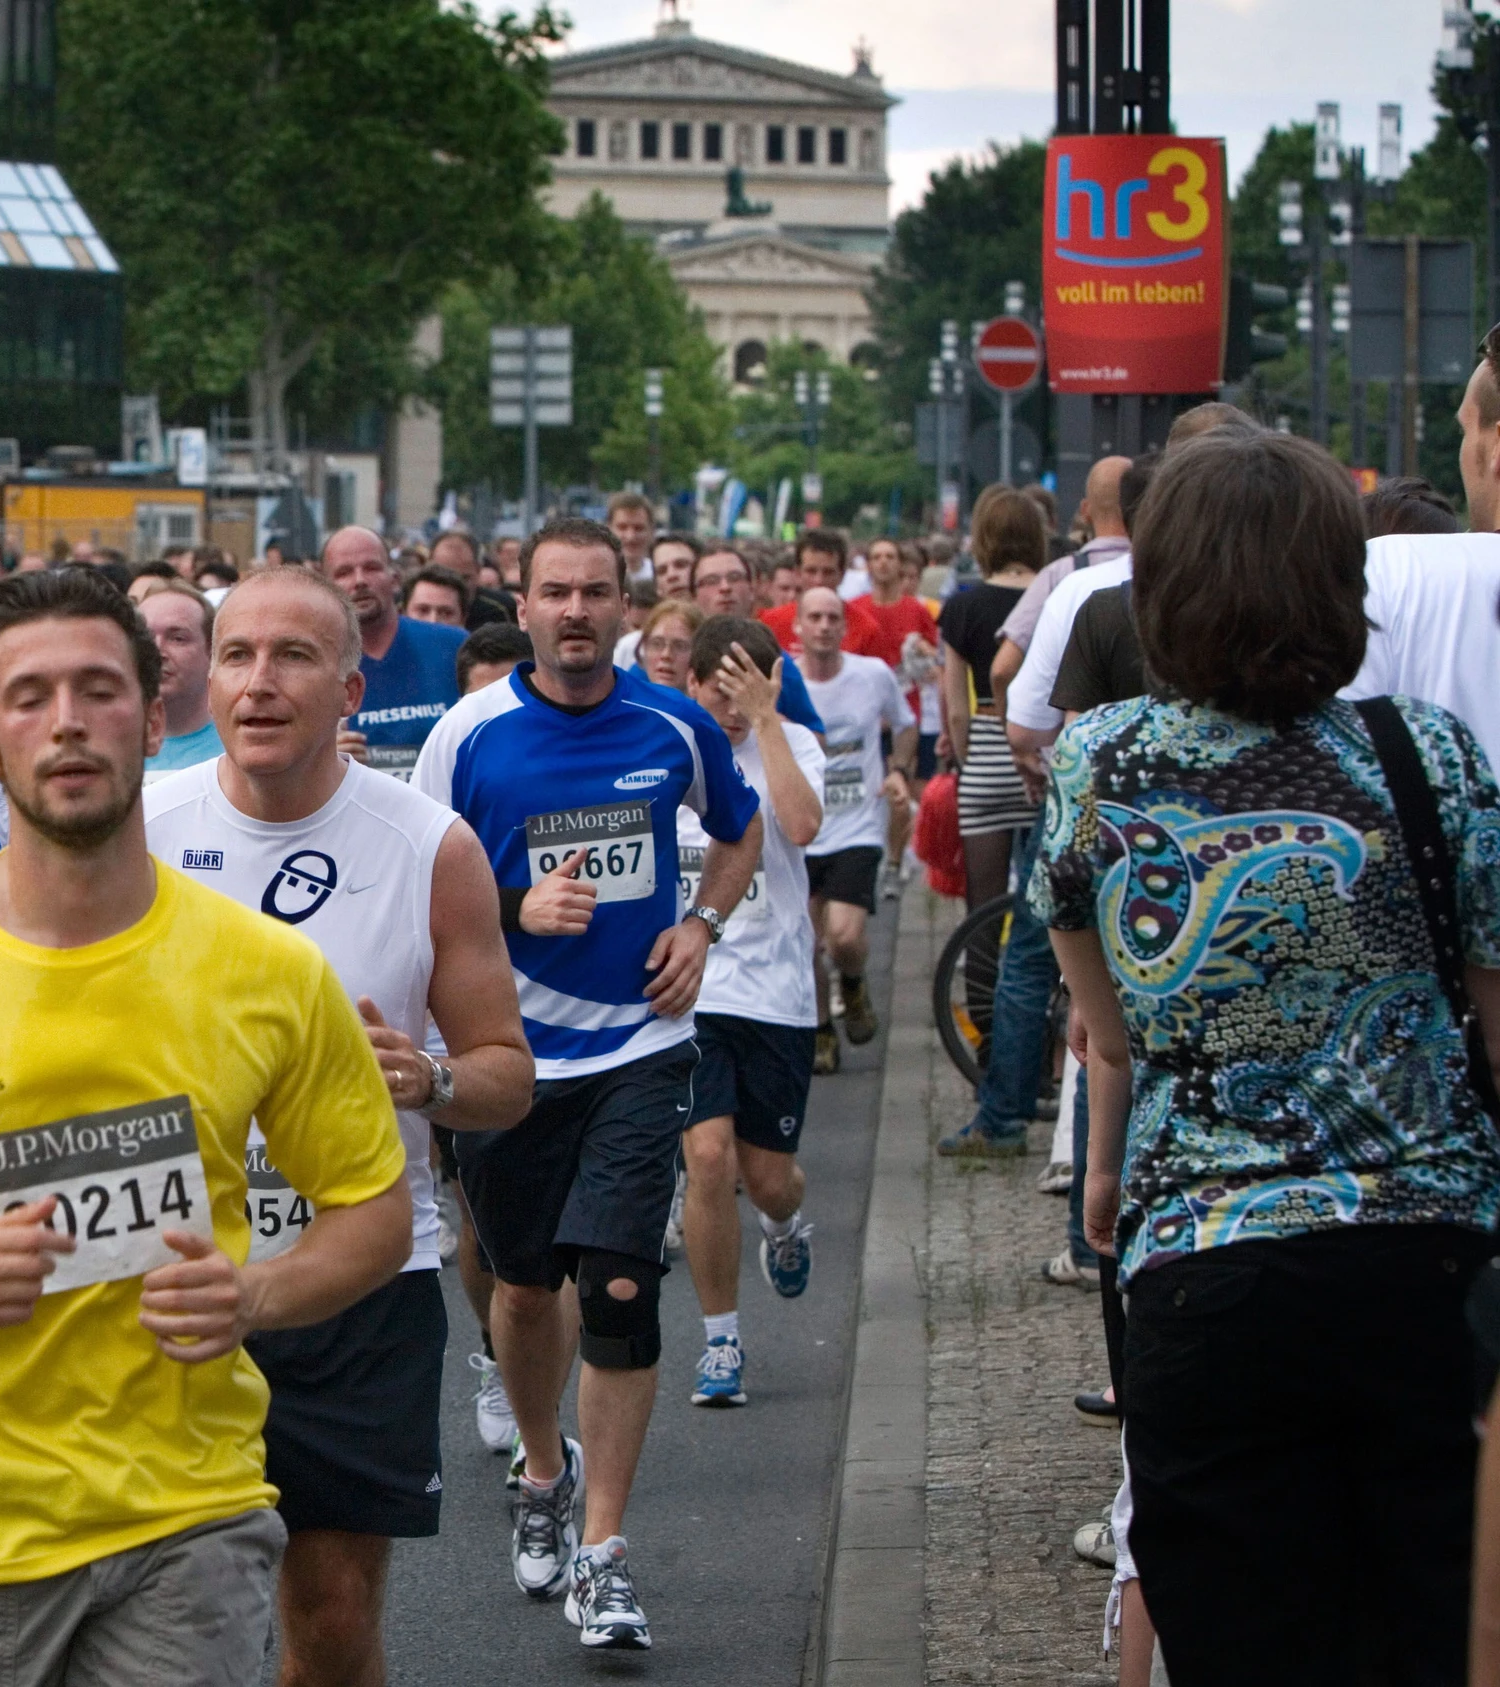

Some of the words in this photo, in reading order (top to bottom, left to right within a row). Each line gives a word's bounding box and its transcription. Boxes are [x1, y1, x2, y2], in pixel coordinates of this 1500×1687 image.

[1056, 147, 1210, 241] hr3
[1056, 281, 1096, 304] voll
[1102, 281, 1128, 304] im
[1135, 280, 1205, 304] leben!
[1059, 366, 1128, 381] www.hr3.de
[357, 702, 447, 726] FRESENIUS
[621, 774, 665, 785] SAMSUNG
[533, 807, 645, 835] J.P.Morgan
[185, 849, 220, 867] DÜRR
[3, 1168, 194, 1241] 0214
